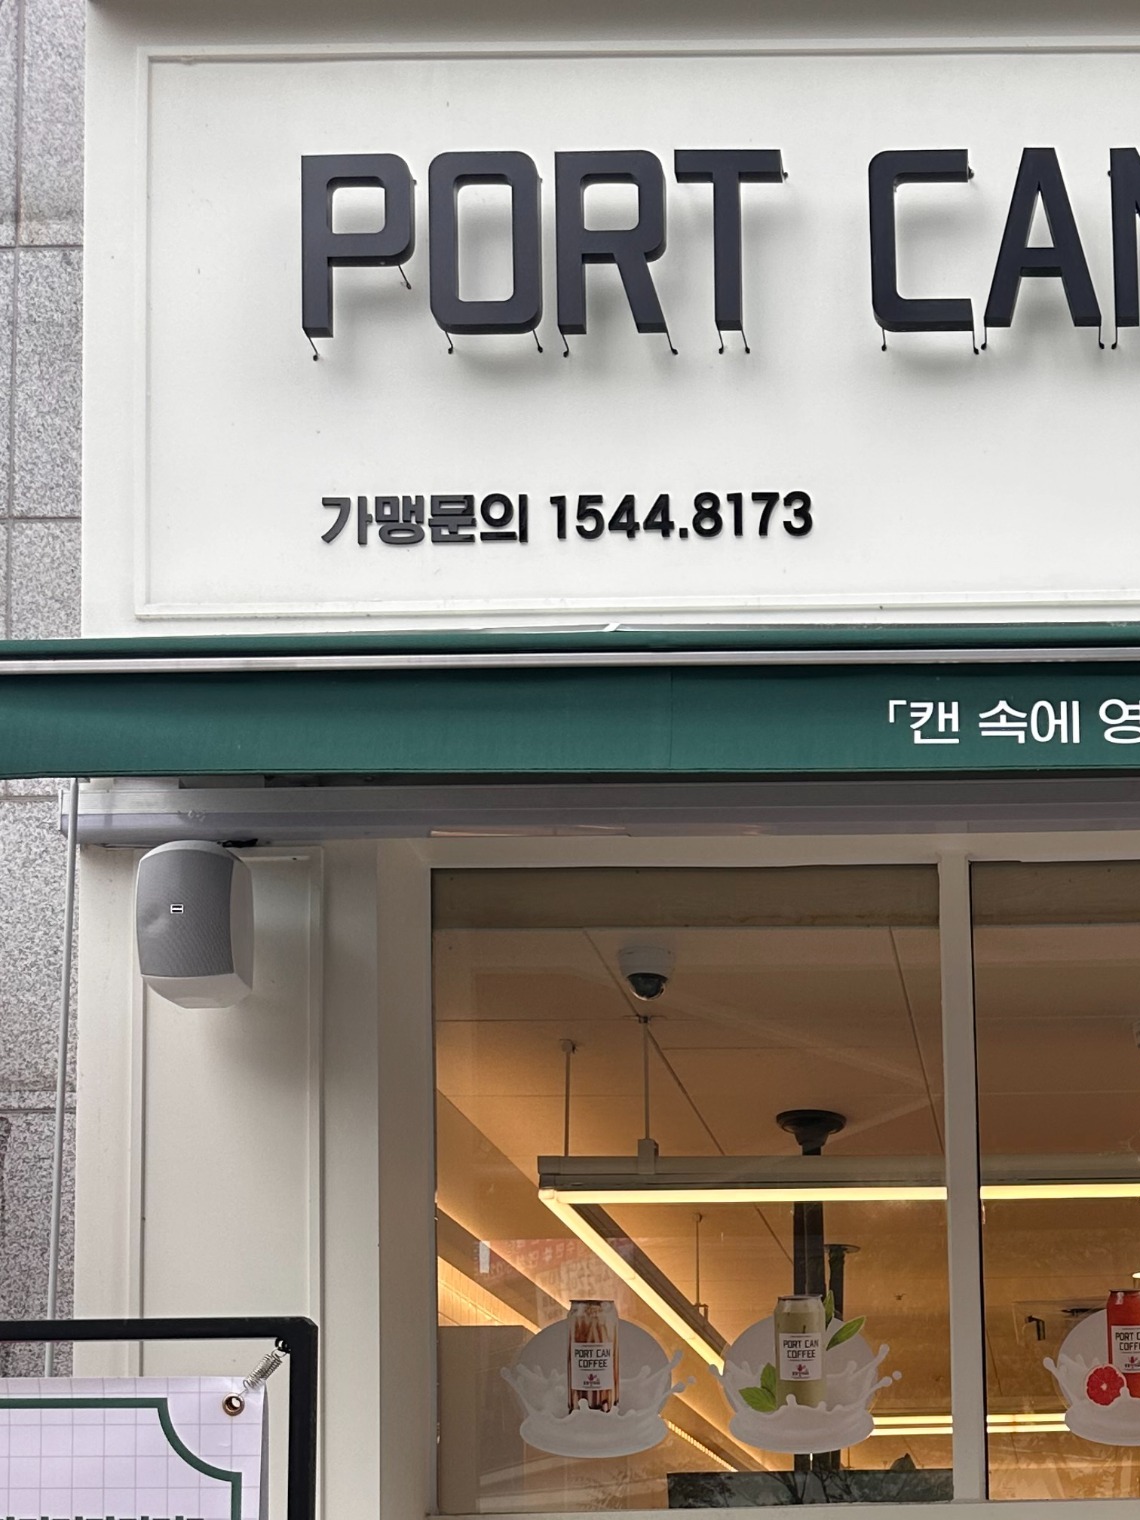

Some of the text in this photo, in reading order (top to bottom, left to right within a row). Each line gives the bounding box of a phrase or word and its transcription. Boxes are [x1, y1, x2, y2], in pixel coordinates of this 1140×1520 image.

[301, 148, 785, 338] PORT
[321, 490, 814, 545] 가맹문의 1544.8173
[887, 700, 960, 746] 「캔
[978, 700, 1081, 745] 속에
[1115, 1332, 1134, 1341] PORT
[783, 1339, 819, 1348] PORT CAN
[574, 1349, 611, 1358] PORT CAN
[787, 1350, 816, 1359] COFFEE
[579, 1359, 608, 1368] COFFEE
